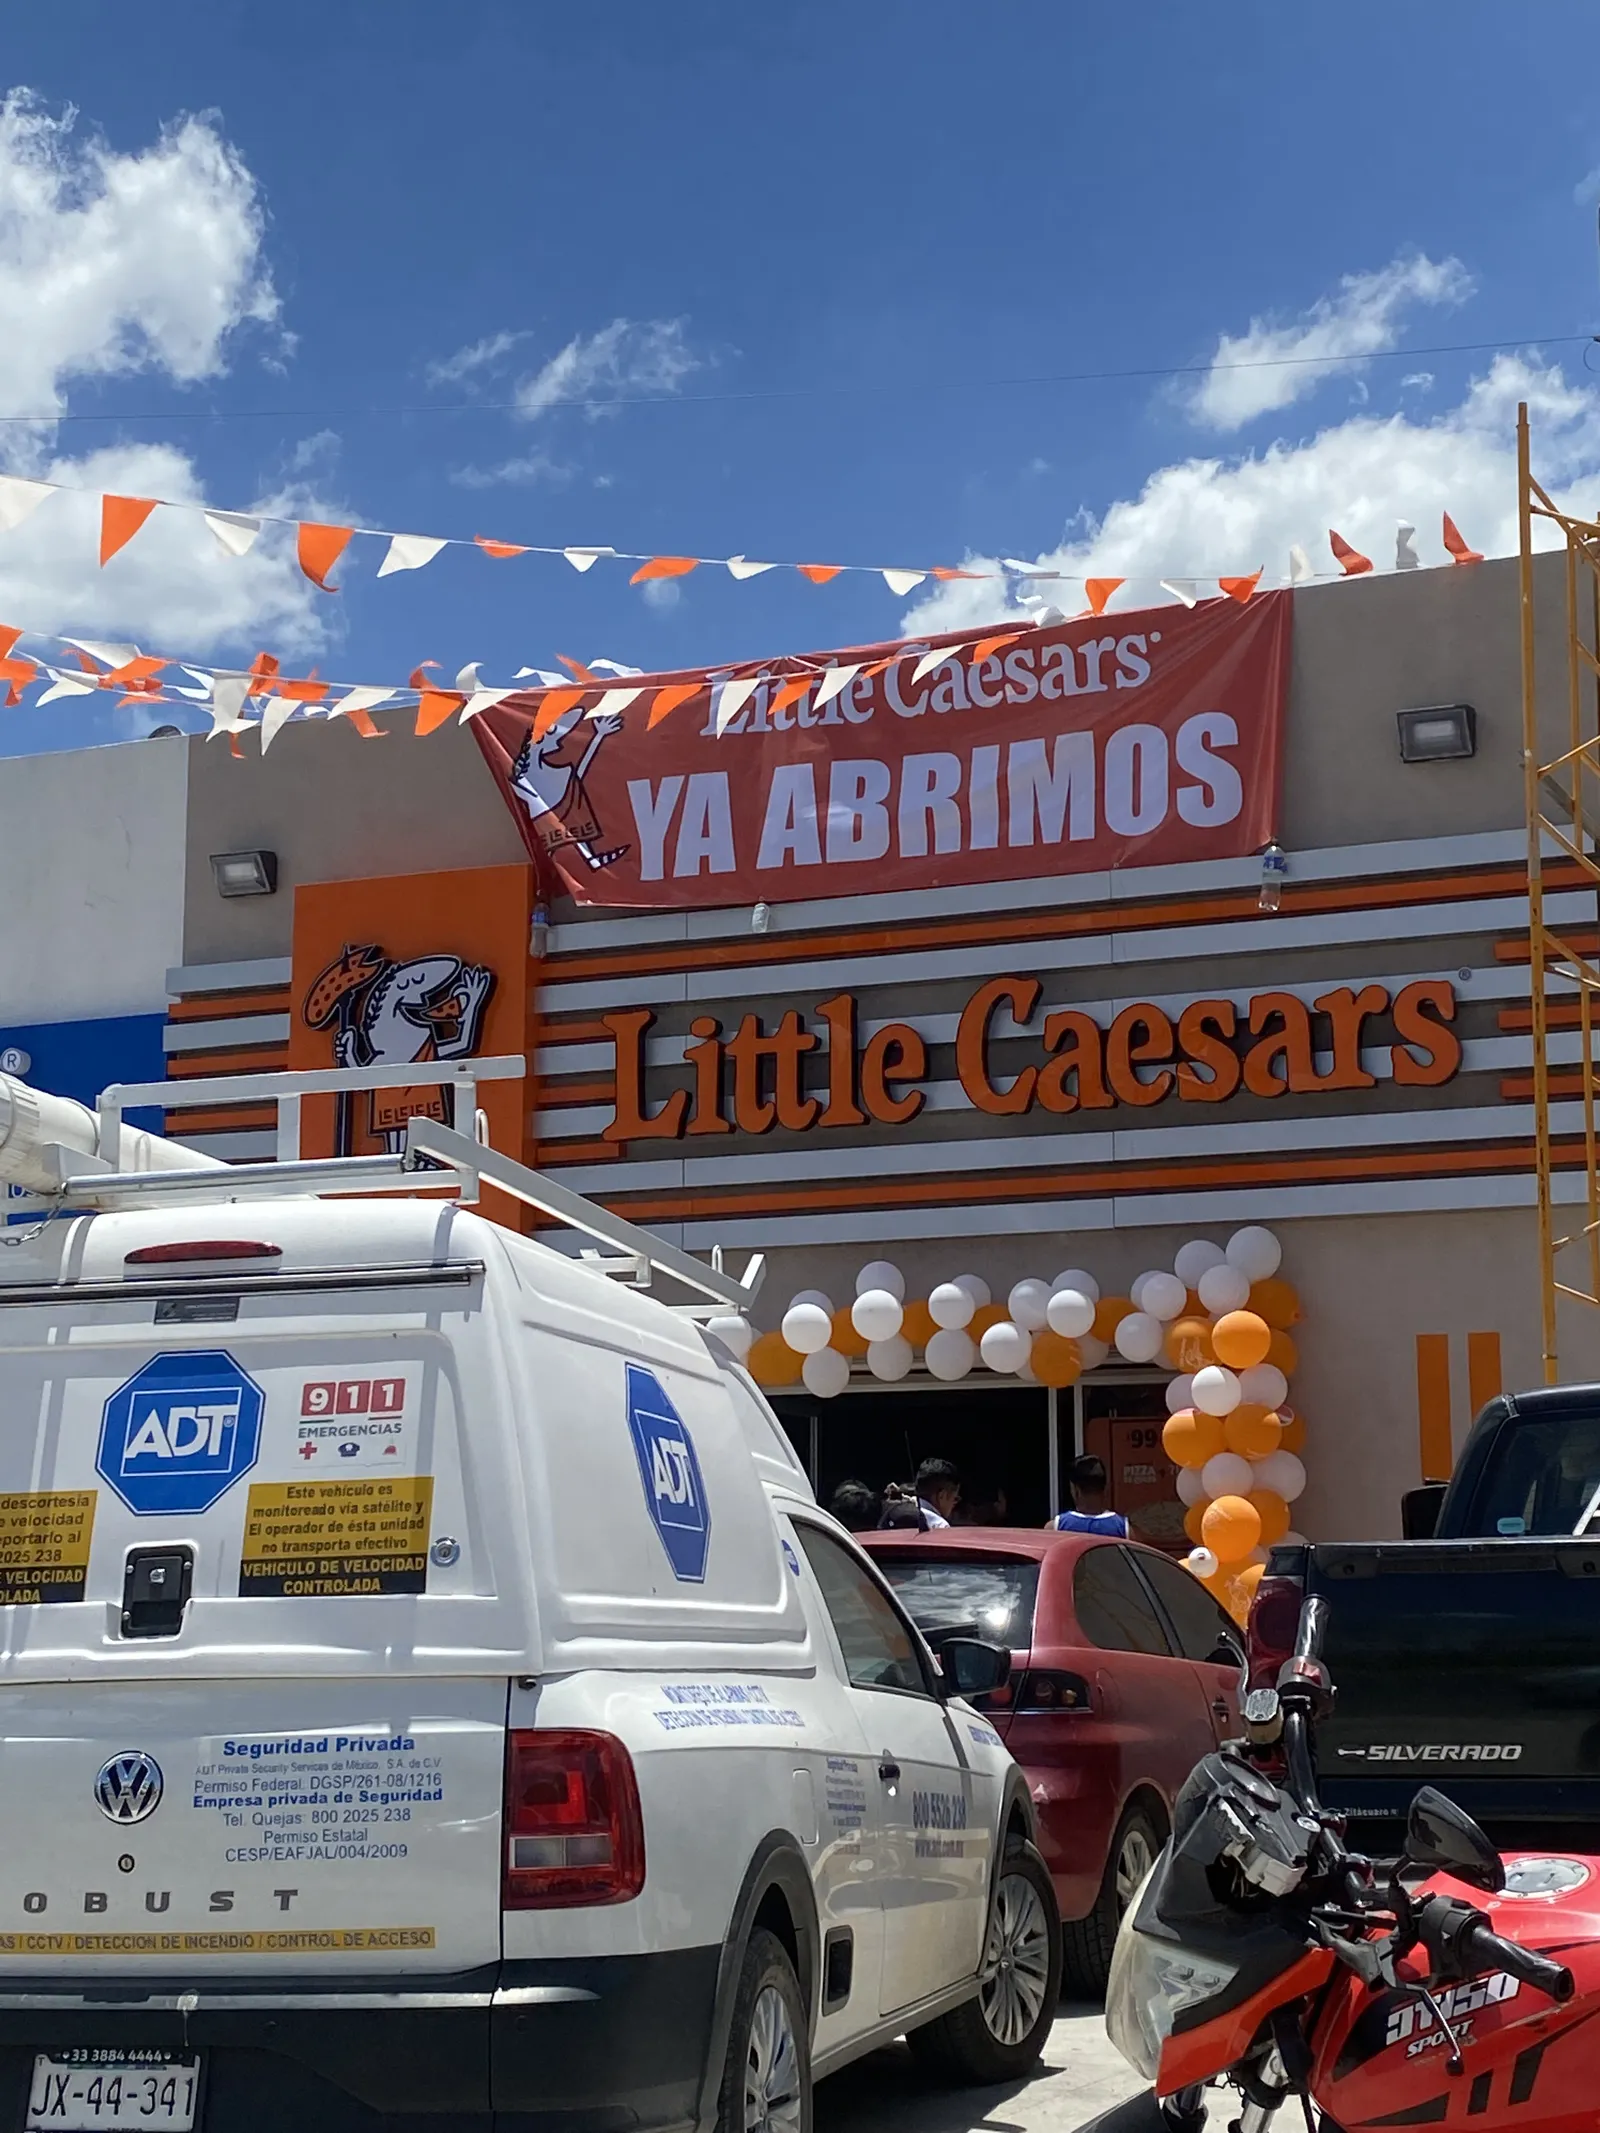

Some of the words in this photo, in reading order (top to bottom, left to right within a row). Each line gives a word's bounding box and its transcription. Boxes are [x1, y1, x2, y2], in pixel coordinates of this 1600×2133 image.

[700, 658, 875, 736] Little
[884, 631, 1151, 718] Caesars
[626, 768, 737, 882] YA
[756, 711, 1244, 871] ABRIMOS
[602, 994, 929, 1143] Little
[957, 977, 1456, 1116] Caesars
[306, 1382, 400, 1413] 911
[124, 1404, 239, 1458] ADT
[298, 1423, 402, 1439] EMERGENCIAS
[650, 1435, 695, 1508] ADT
[287, 1486, 316, 1499] Este
[378, 1484, 393, 1495] es
[253, 1503, 335, 1518] monitoreado
[415, 1502, 424, 1515] y
[11, 1512, 84, 1527] velocidad
[249, 1523, 261, 1536] El
[265, 1522, 324, 1538] operador
[328, 1520, 344, 1533] de
[380, 1516, 424, 1531] unidad
[0, 1531, 63, 1548] portarlo
[67, 1530, 81, 1543] al
[262, 1542, 277, 1554] no
[282, 1540, 350, 1555] transporta
[355, 1537, 408, 1550] efectivo
[34, 1549, 62, 1562] 238
[320, 1559, 340, 1574] DE
[343, 1557, 425, 1573] VELOCIDAD
[5, 1569, 84, 1585] VELOCIDAD
[283, 1577, 381, 1595] CONTROLADA
[223, 1738, 328, 1759] Seguridad
[335, 1735, 415, 1752] Privada
[1366, 1744, 1523, 1760] SILVERADO
[252, 1762, 289, 1775] Security
[291, 1761, 329, 1773] Services
[331, 1761, 344, 1771] de
[409, 1758, 421, 1768] de
[194, 1780, 248, 1793] Permiso
[310, 1772, 442, 1790] DGSP/261-08/1216
[193, 1795, 263, 1810] Empresa
[268, 1791, 329, 1808] privada
[333, 1791, 353, 1804] de
[359, 1788, 443, 1805] Seguridad
[311, 1810, 338, 1824] 800
[343, 1808, 379, 1823] 2025
[384, 1807, 411, 1822] 238
[264, 1830, 318, 1844] Permiso
[322, 1828, 368, 1842] Estatal
[27, 1935, 64, 1950] CCTV
[75, 1935, 156, 1950] DETECCION
[161, 1935, 181, 1949] DE
[185, 1934, 254, 1949] INCENDIO
[266, 1934, 341, 1948] CONTROL
[343, 1933, 364, 1946] DE
[368, 1931, 431, 1946] ACCESO
[71, 2049, 88, 2062] 33
[91, 2049, 125, 2062] 3884
[128, 2050, 162, 2062] 4444
[31, 2074, 193, 2117] JX-44-341
